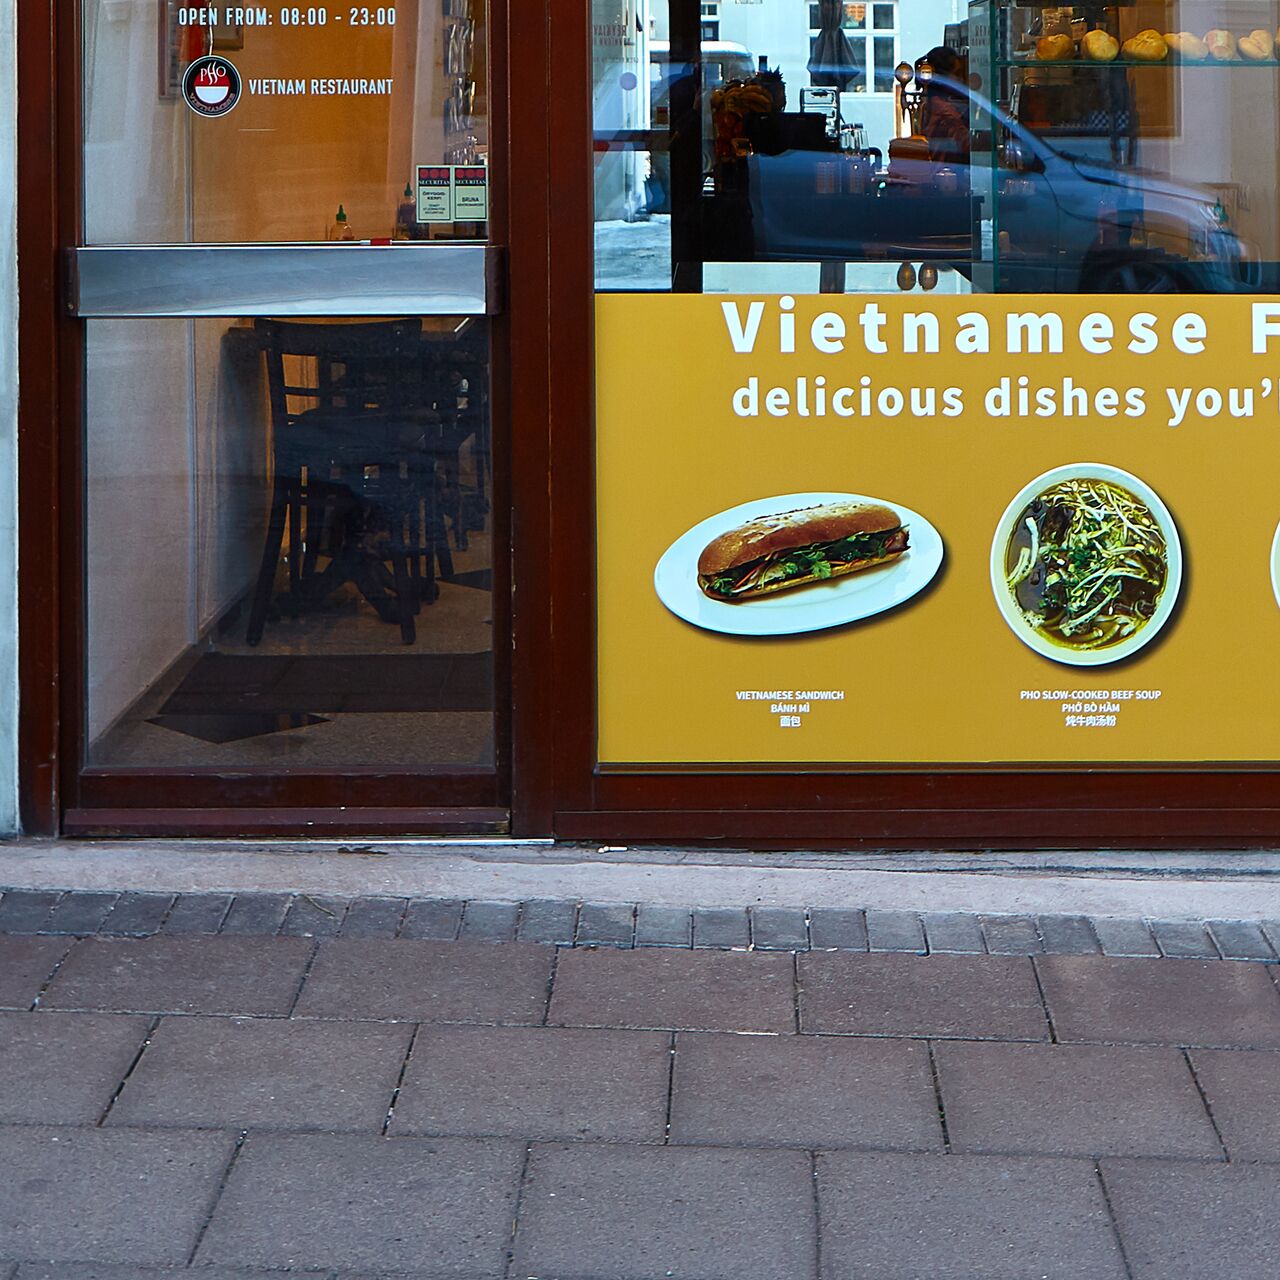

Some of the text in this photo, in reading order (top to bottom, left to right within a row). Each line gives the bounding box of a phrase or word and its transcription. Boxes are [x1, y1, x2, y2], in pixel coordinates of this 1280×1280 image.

[178, 7, 218, 26] OPEN
[226, 7, 273, 26] FROM:
[280, 7, 328, 26] 08:00
[349, 7, 397, 26] 23:00
[200, 61, 226, 85] PHO
[248, 78, 394, 95] VIETNAM RESTAURANT
[721, 295, 1208, 355] Vietnamese
[732, 375, 964, 417] delicious
[984, 375, 1147, 417] dishes
[736, 691, 844, 700] VIETNAMESE SANDWICH
[1020, 690, 1162, 700] PHO SLOW-COOKED BEEF SOUP
[771, 702, 797, 713] BÁNH
